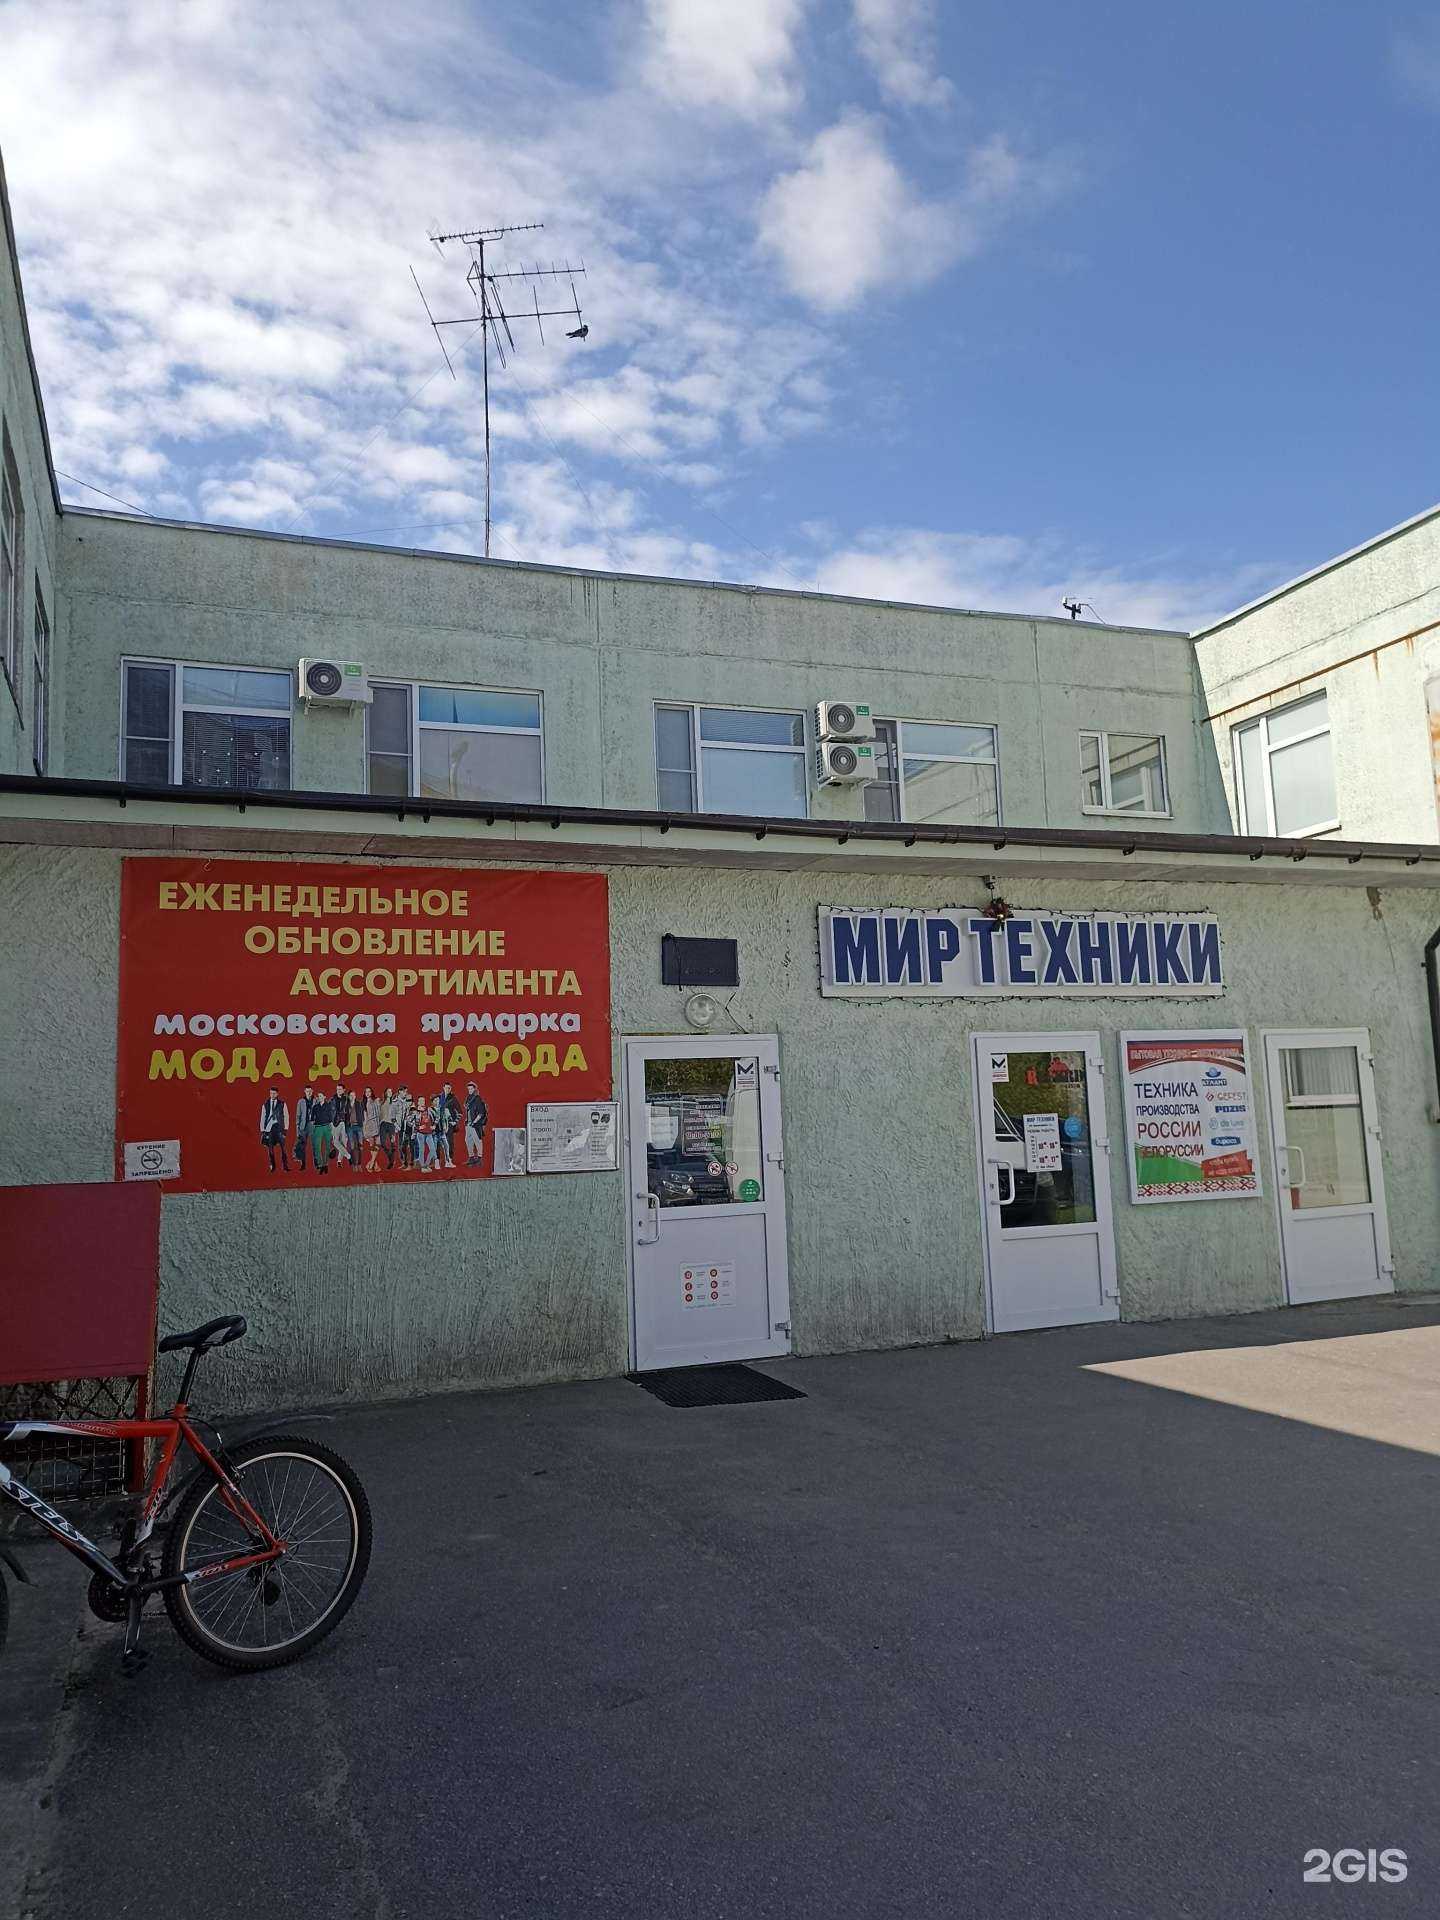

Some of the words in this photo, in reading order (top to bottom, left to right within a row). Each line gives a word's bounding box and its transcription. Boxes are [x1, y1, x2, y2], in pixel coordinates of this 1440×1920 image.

[158, 882, 469, 918] ЕЖЕНЕДЕЛЬНОЕ
[243, 926, 506, 956] ОБНОВЛЕНИЕ
[830, 916, 961, 985] МИР
[966, 917, 1222, 986] ТЕХНИКИ
[289, 967, 583, 997] АССОРТИМЕНТА
[153, 1013, 396, 1037] московская
[420, 1011, 582, 1041] ярмарка
[148, 1046, 292, 1083] МОДА
[308, 1045, 400, 1082] ДЛЯ
[416, 1043, 588, 1078] НАРОДА
[1134, 1082, 1199, 1099] ТЕХНИКА
[1136, 1103, 1200, 1117] ПРОИЗВОДСТВА
[1215, 1105, 1247, 1113] POZIS
[1137, 1120, 1202, 1139] РОССИИ
